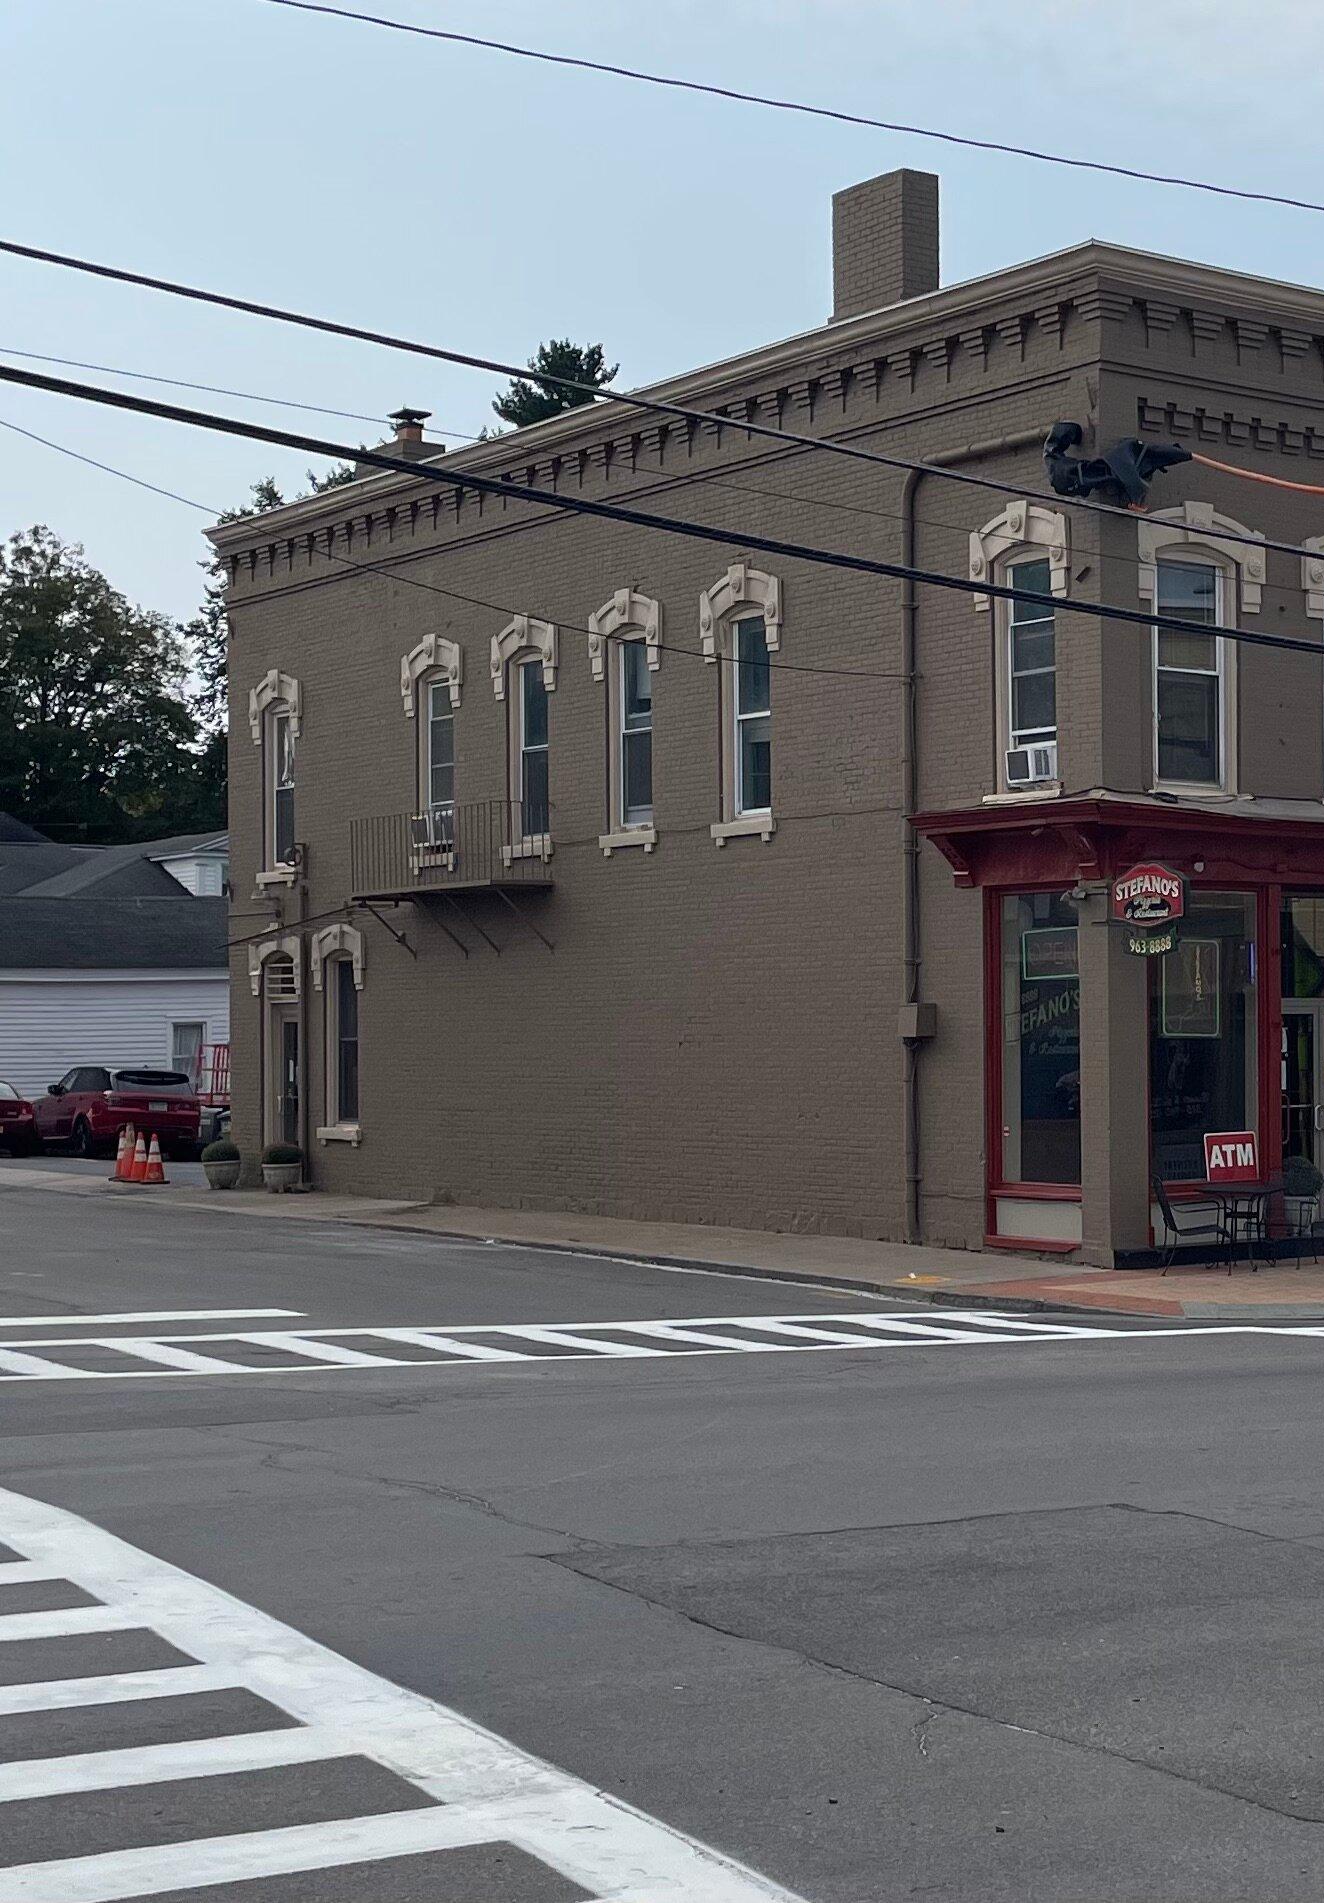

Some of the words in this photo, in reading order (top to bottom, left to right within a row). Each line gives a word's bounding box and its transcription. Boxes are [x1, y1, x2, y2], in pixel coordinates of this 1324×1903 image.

[1116, 875, 1179, 901] STEFANO'S
[1129, 936, 1172, 954] 963-8888
[1210, 1143, 1254, 1168] ATM
